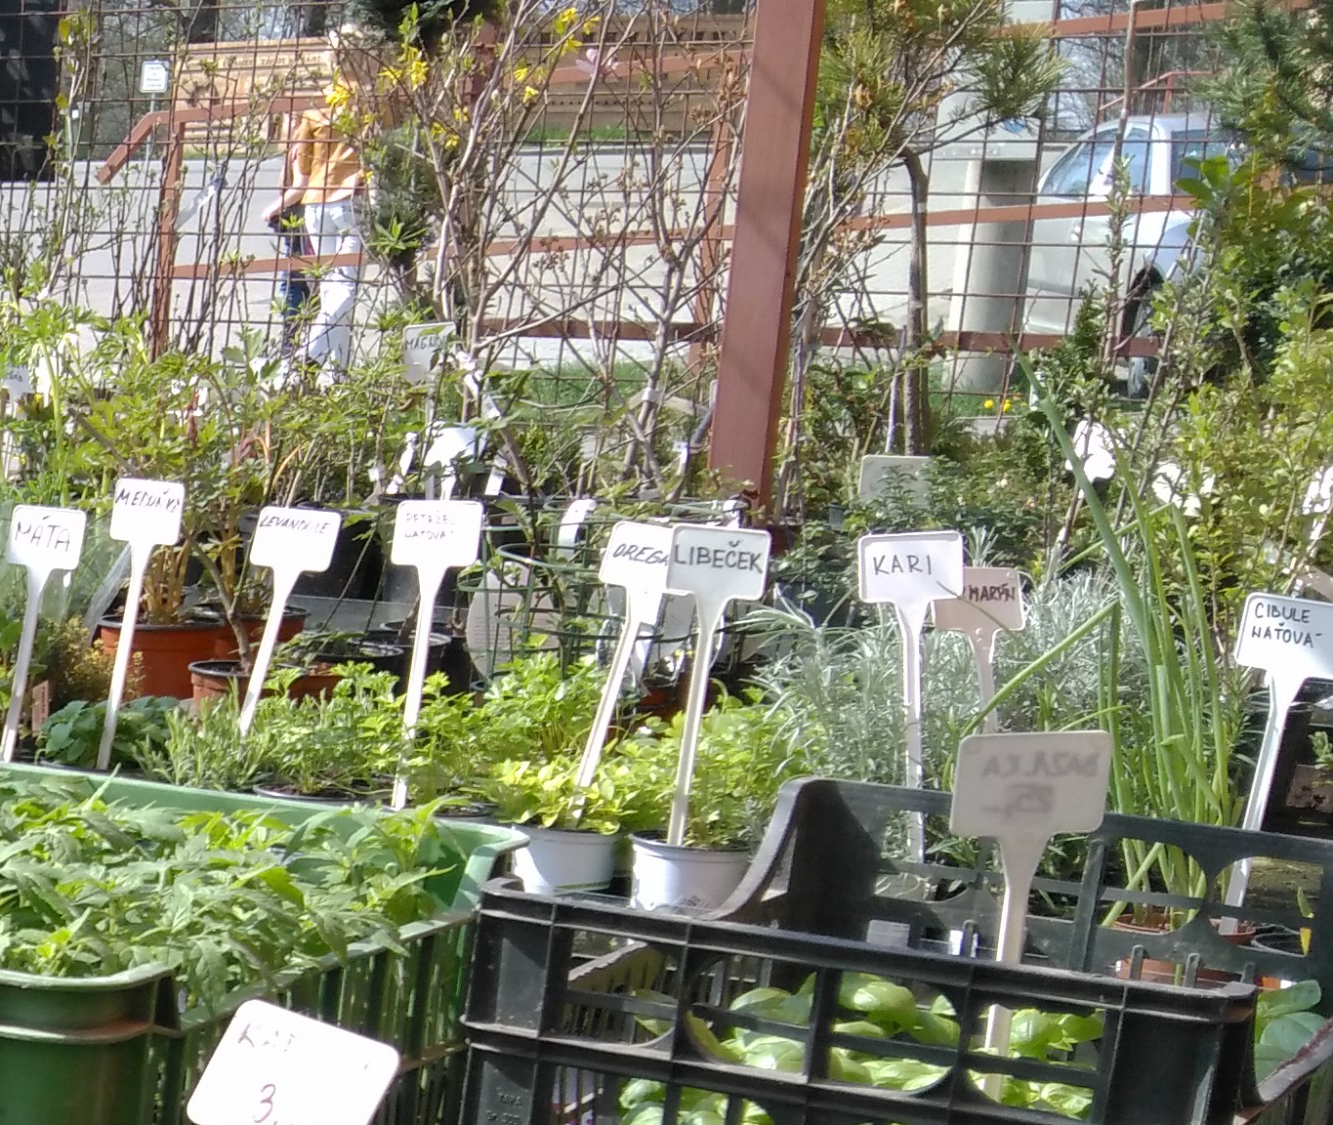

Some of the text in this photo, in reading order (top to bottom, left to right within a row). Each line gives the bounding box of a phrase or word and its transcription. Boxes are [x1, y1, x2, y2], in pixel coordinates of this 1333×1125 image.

[15, 514, 71, 552] MÁTA
[612, 543, 669, 566] OREGA
[674, 539, 763, 574] LIBEČEK
[873, 554, 933, 576] KARI
[1255, 602, 1311, 623] CIBULE
